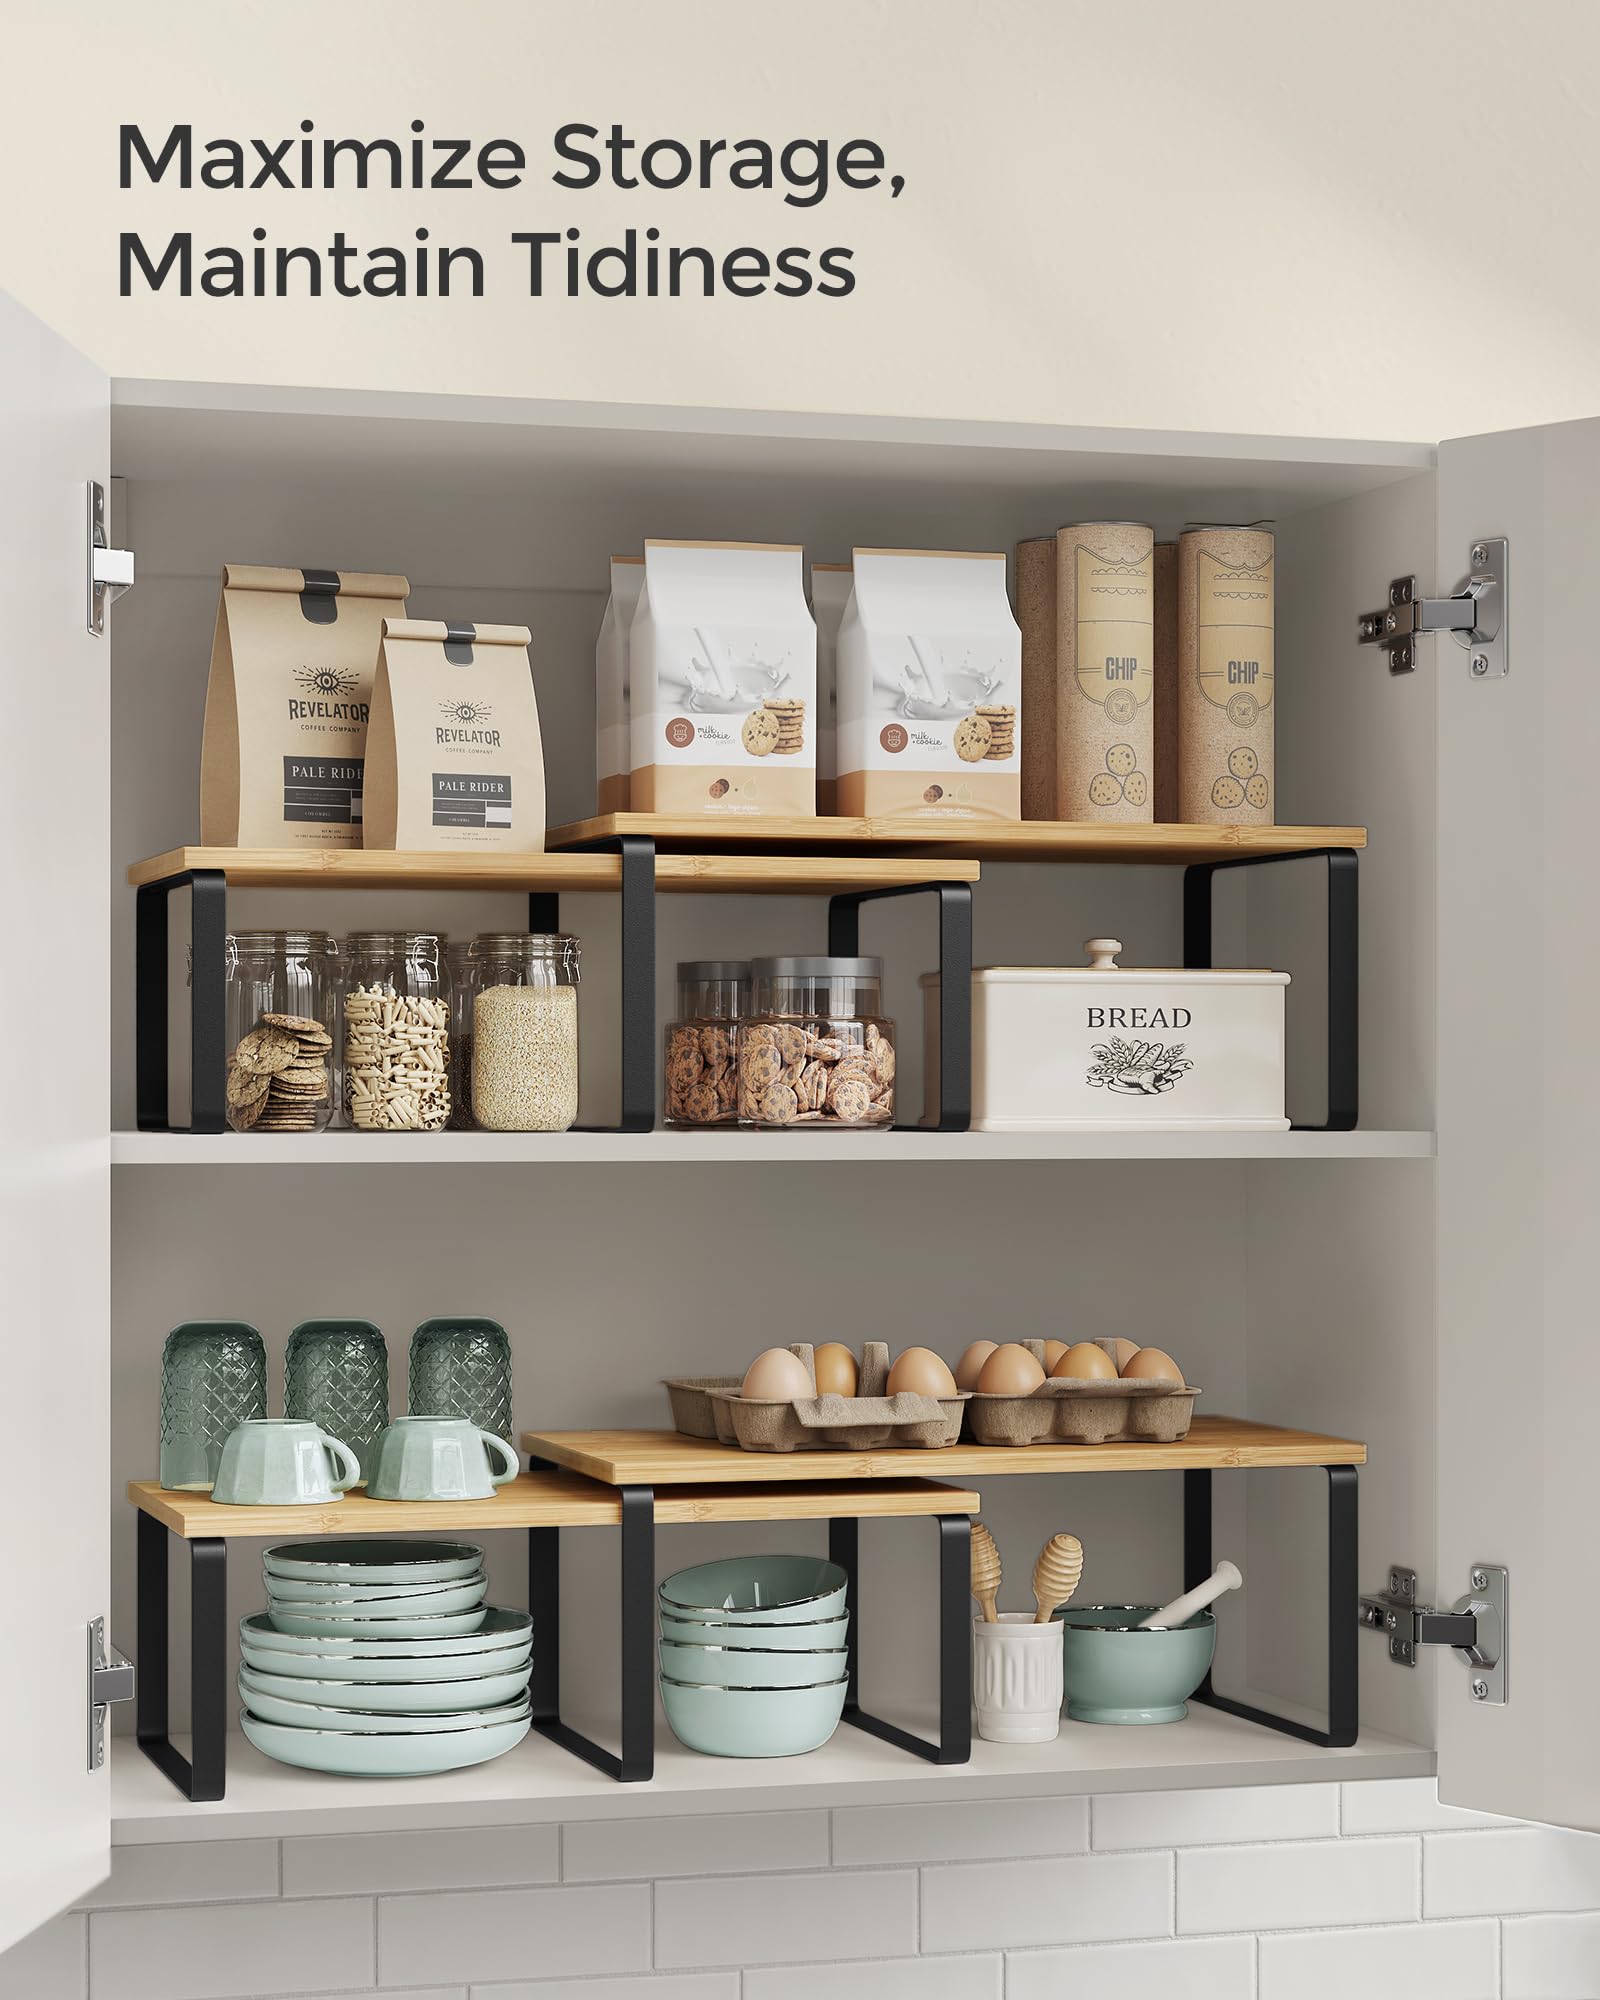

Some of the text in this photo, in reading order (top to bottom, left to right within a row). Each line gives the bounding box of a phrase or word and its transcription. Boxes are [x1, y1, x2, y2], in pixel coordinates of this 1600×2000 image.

[1105, 656, 1137, 681] CHIP
[1227, 660, 1259, 685] CHIP
[288, 699, 370, 724] REVELATOR
[300, 724, 361, 733] COFFEE COMPANY
[435, 727, 502, 748] REVELATOR
[697, 725, 717, 734] milk
[910, 731, 929, 740] milk
[292, 765, 364, 780] PALE RIDE
[439, 780, 505, 793] PALE RIDER
[1086, 1007, 1192, 1029] BREAD
